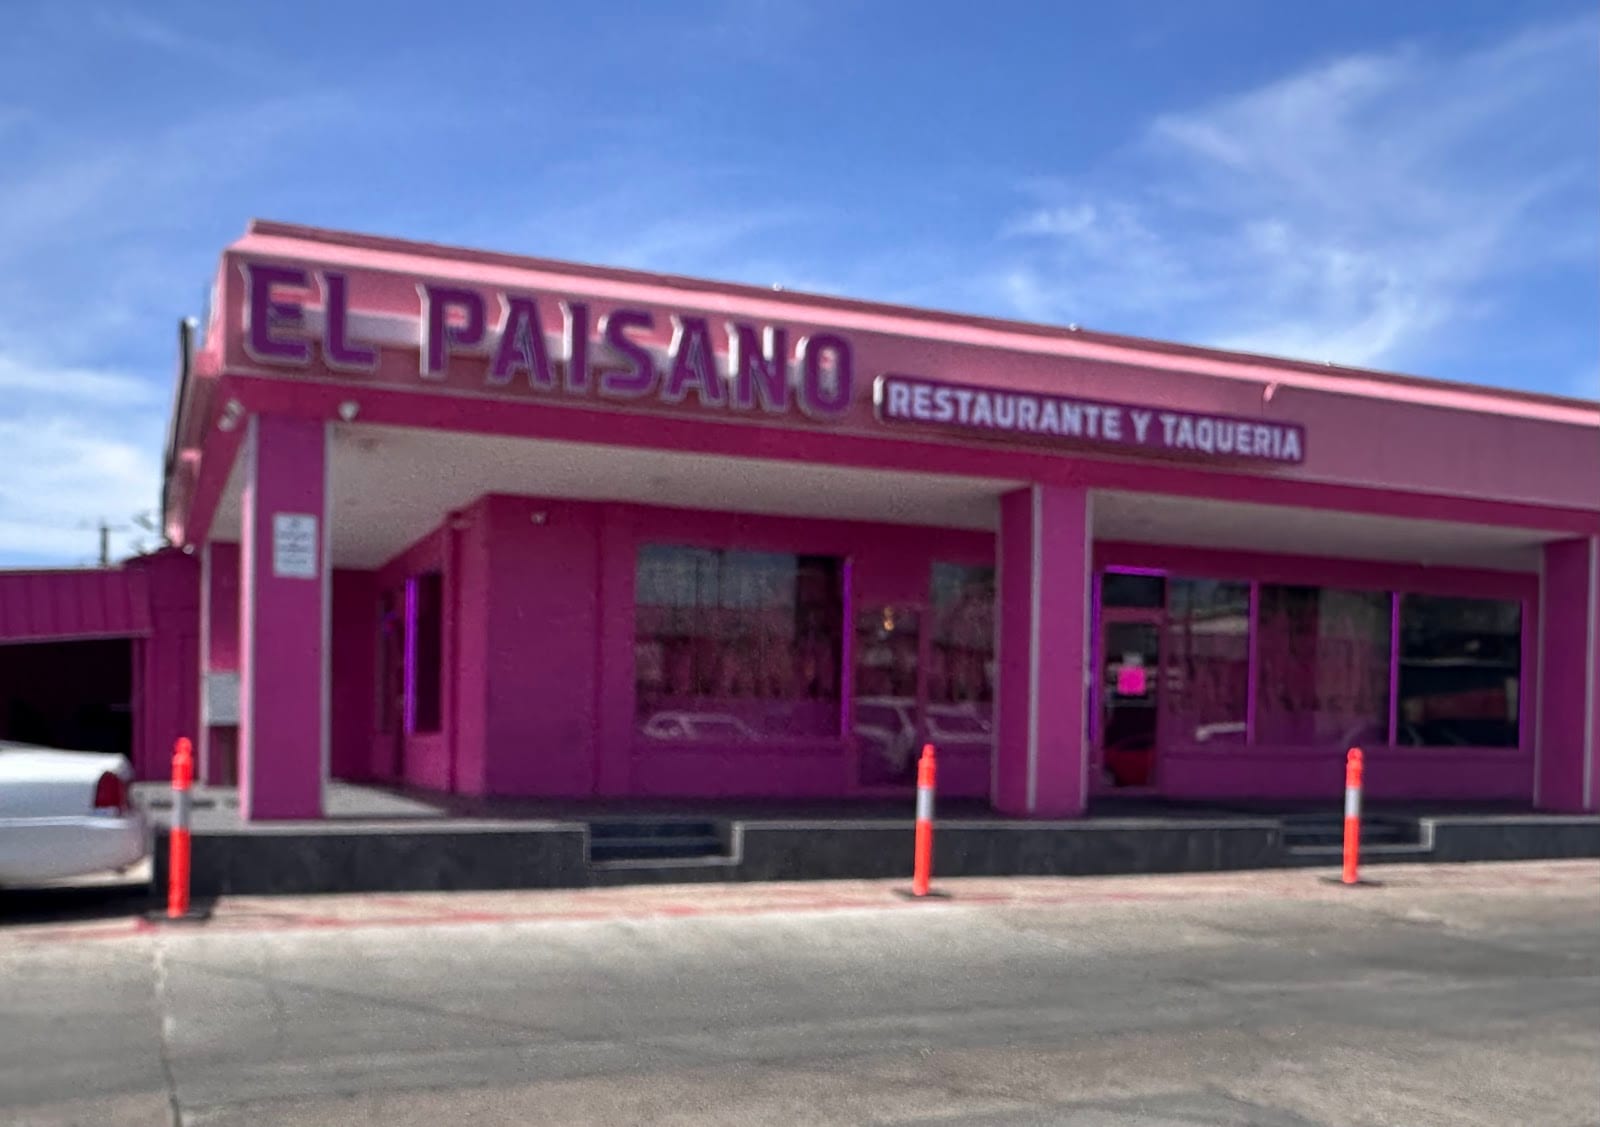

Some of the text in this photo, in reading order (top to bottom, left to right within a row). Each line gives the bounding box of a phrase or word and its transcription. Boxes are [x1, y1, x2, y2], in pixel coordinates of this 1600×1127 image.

[244, 262, 854, 414] EL PAISANO
[887, 382, 1302, 461] RESTAURANTE Y TAQUERIA
